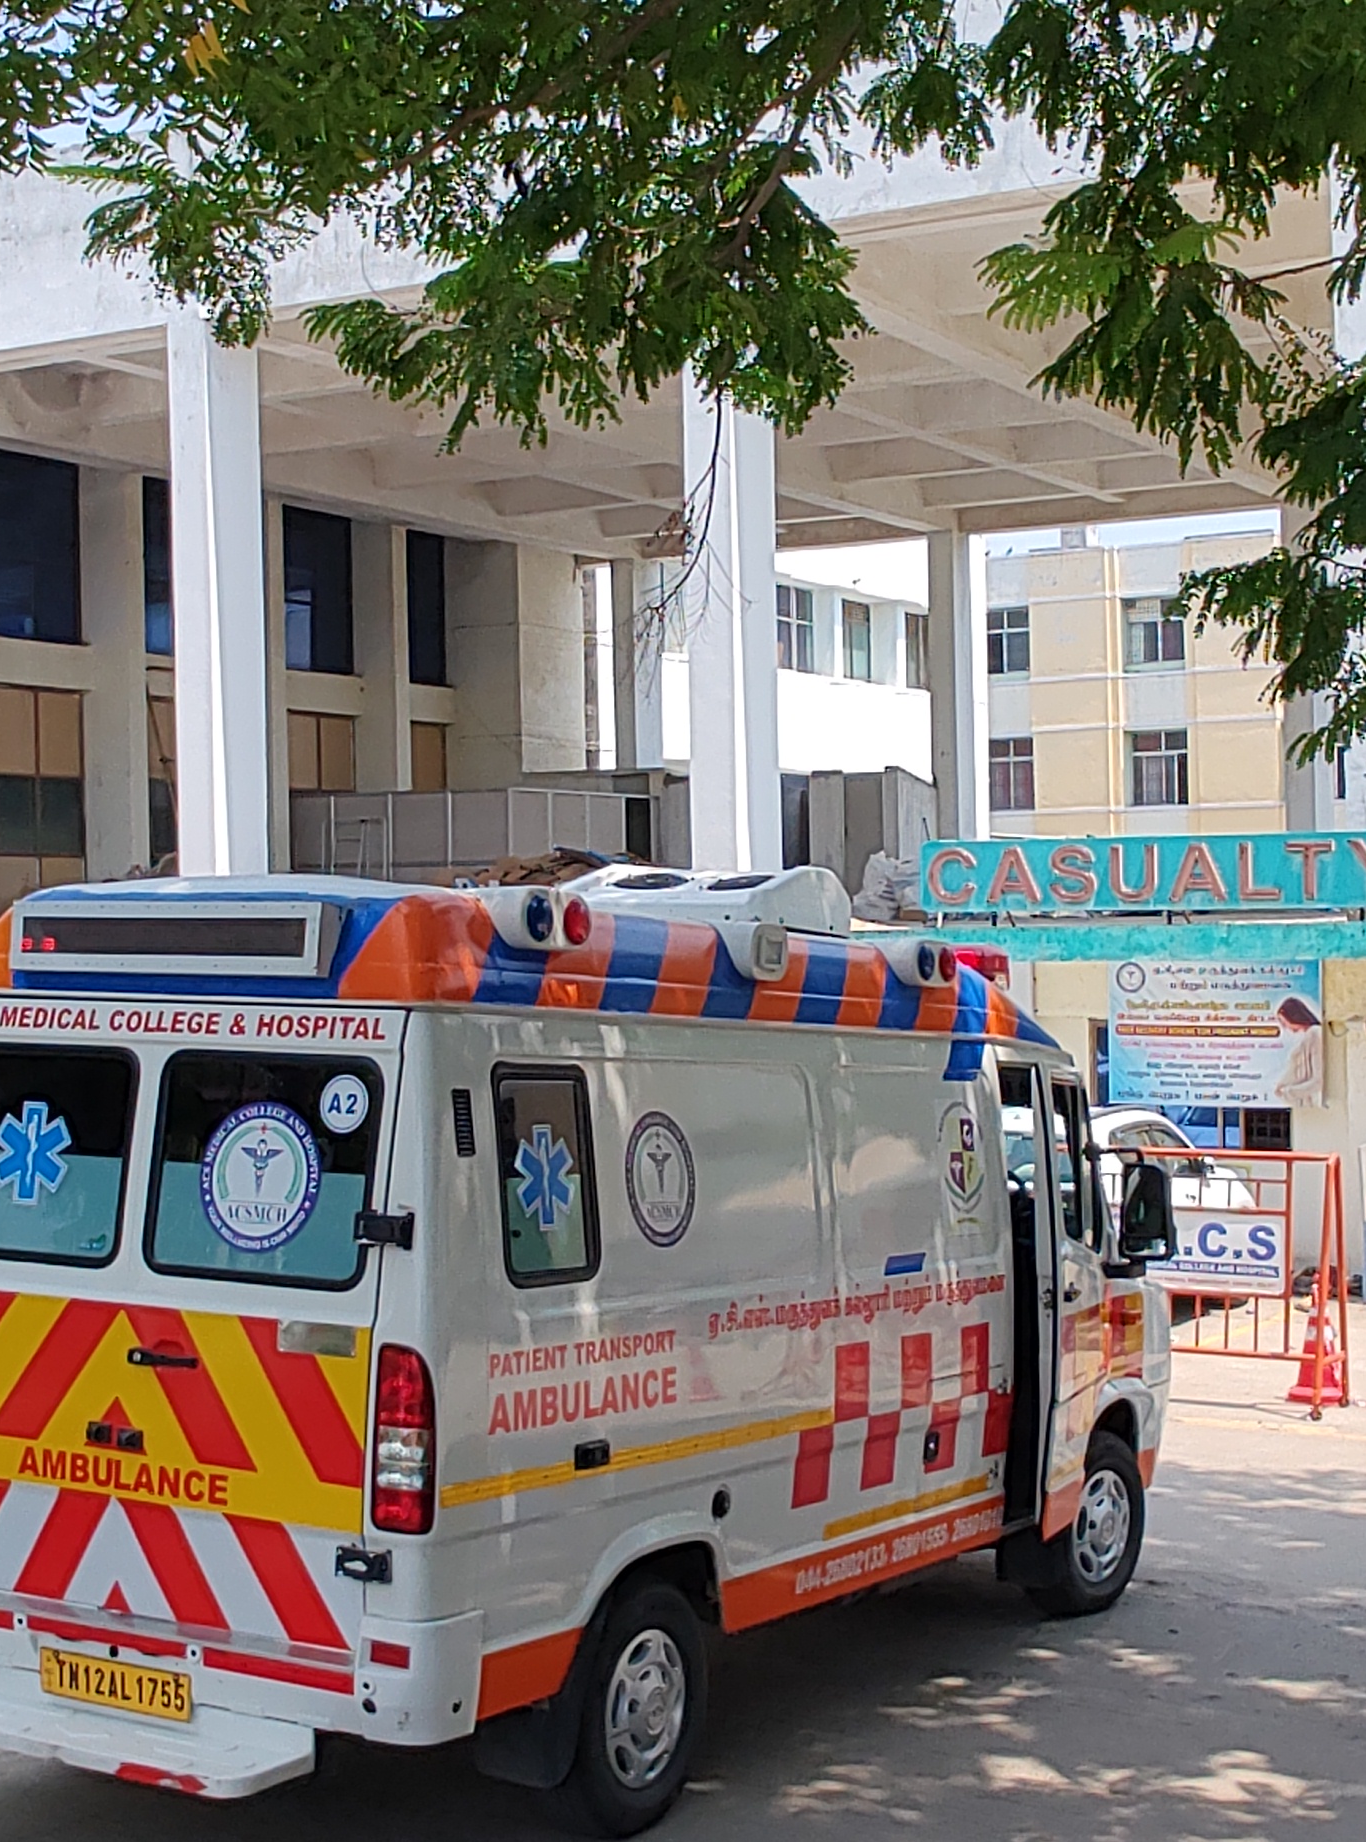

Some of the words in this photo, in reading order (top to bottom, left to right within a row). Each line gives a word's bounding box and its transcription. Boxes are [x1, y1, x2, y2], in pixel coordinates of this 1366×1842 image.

[0, 1007, 100, 1031] MEDICAL
[109, 1010, 220, 1035] COLLEGE
[230, 1013, 247, 1035] &
[257, 1014, 385, 1040] HOSPITAL
[327, 1092, 357, 1114] A2
[239, 1106, 287, 1121] COLLEGE
[287, 1115, 306, 1136] AND
[302, 1135, 319, 1193] HOSPITAL
[1177, 1222, 1277, 1261] .C.S
[489, 1343, 568, 1379] PATIENT
[573, 1329, 677, 1366] TRANSPORT
[488, 1366, 678, 1435] AMBULANCE
[18, 1446, 229, 1506] AMBULANCE
